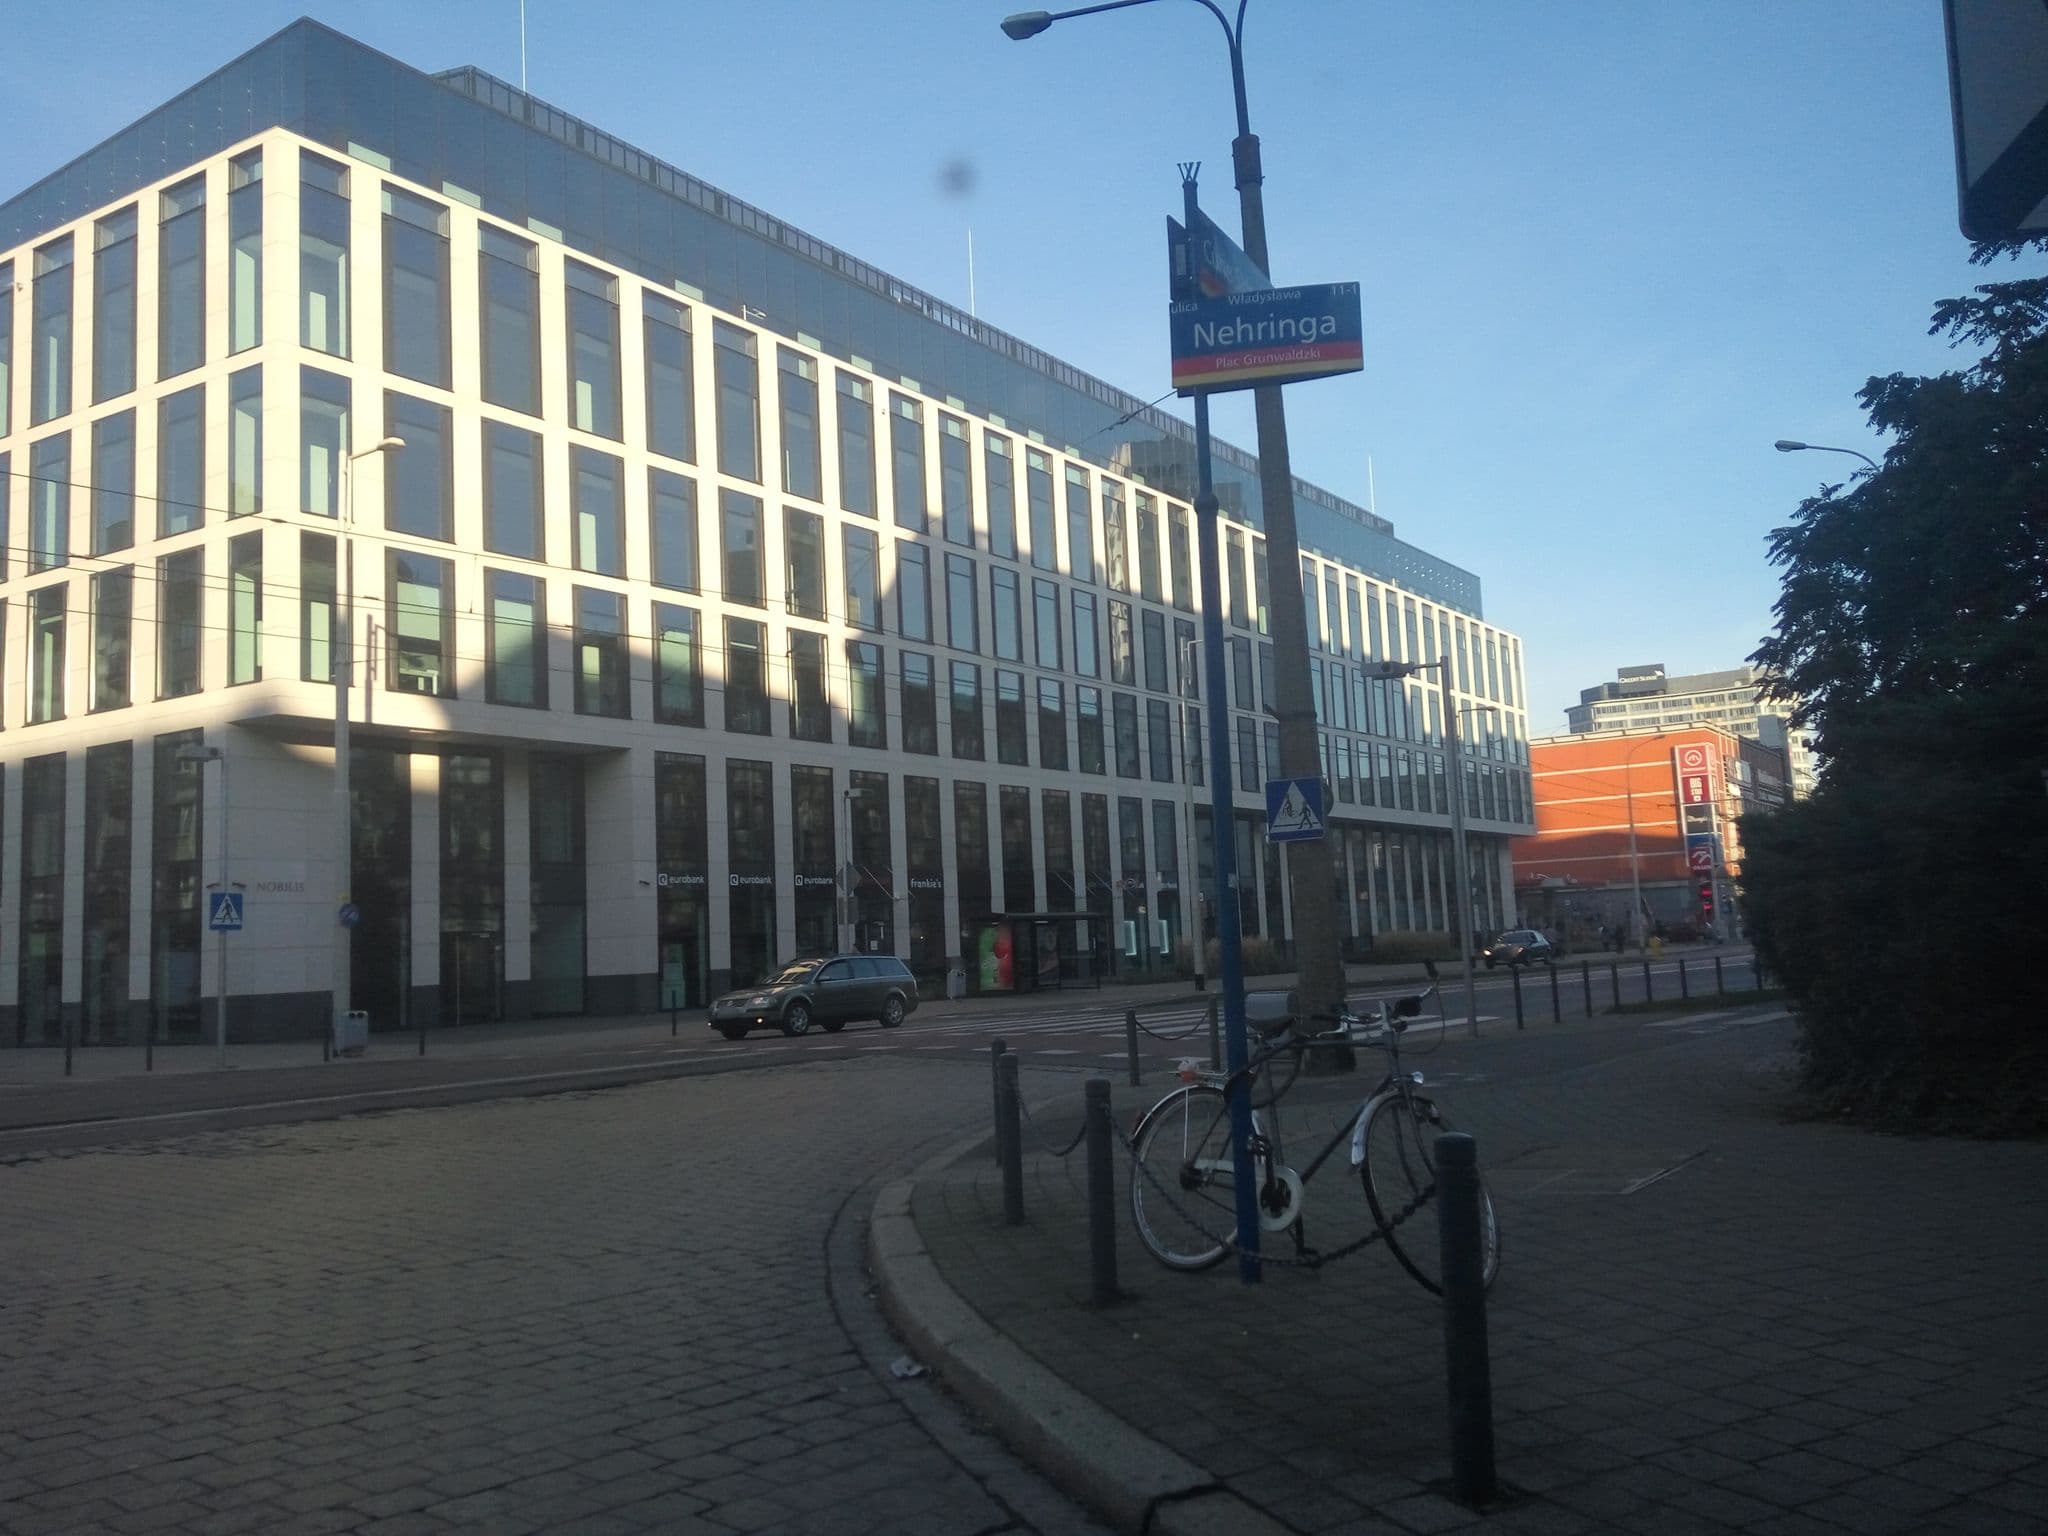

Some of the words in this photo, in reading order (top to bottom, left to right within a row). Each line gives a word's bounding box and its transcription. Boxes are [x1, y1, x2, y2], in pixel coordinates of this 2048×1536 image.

[1171, 303, 1198, 314] ulica
[1194, 313, 1337, 349] Nehringa
[1216, 355, 1240, 369] Plac
[1243, 348, 1321, 366] Grunwaldzki
[669, 874, 705, 884] eurobank
[740, 875, 773, 885] eurobank
[804, 876, 834, 885] eurobank
[257, 882, 305, 892] NOBILIS
